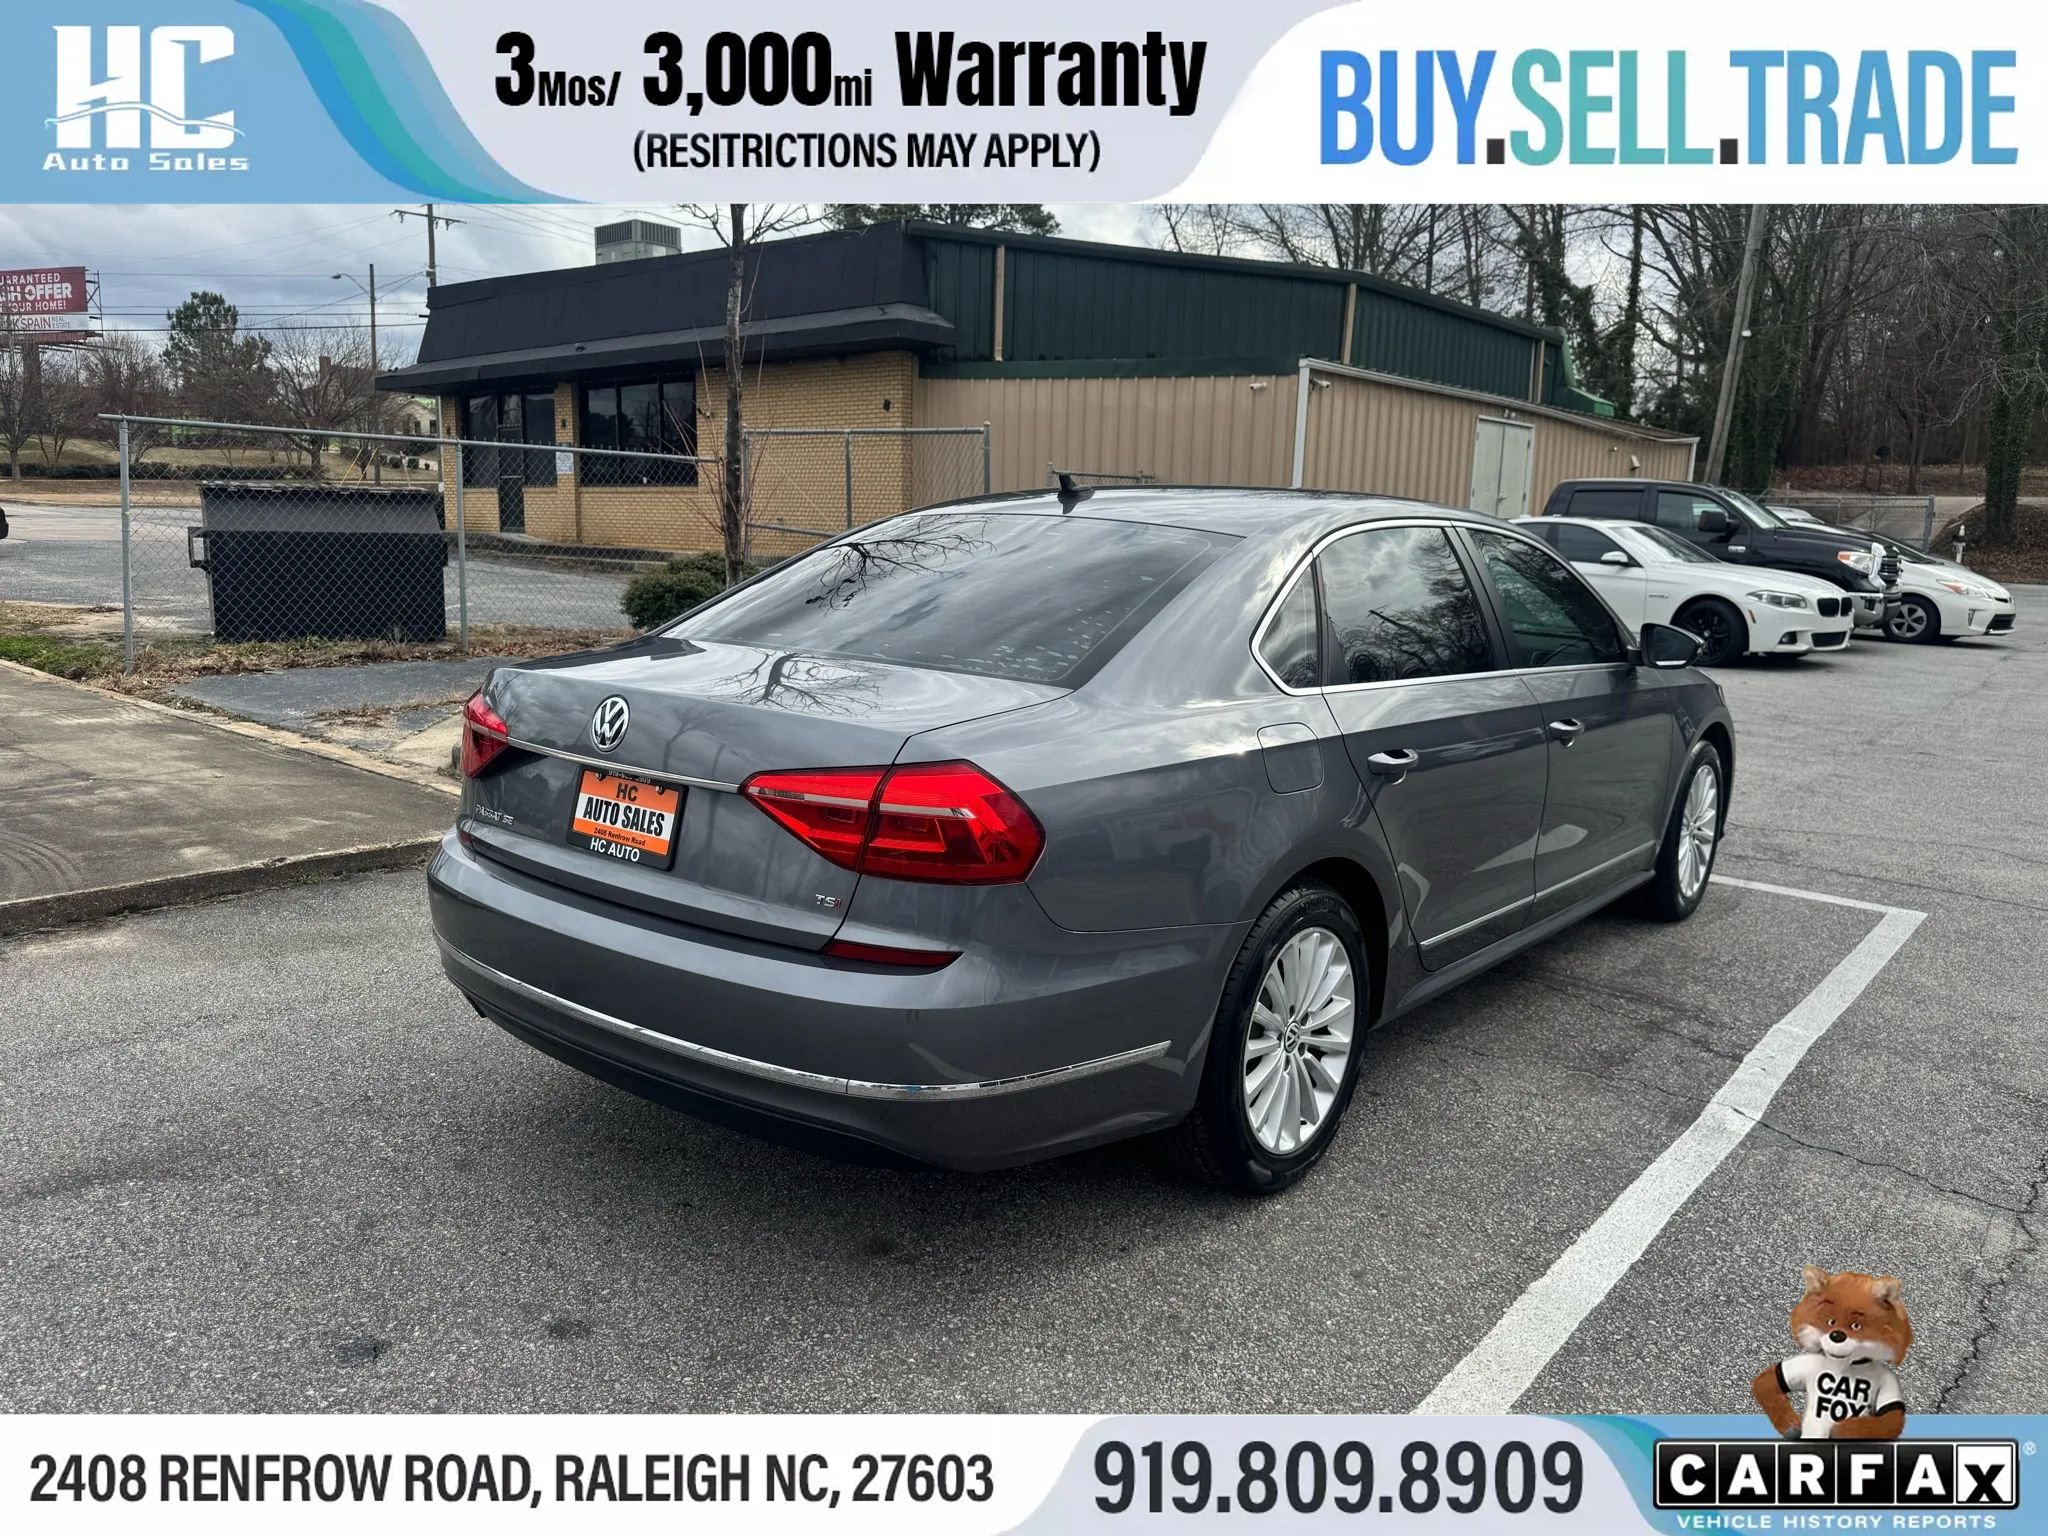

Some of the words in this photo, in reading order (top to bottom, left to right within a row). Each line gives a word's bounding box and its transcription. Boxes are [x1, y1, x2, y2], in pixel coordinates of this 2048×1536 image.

[24, 282, 72, 300] OFFER
[35, 300, 66, 311] HOME!
[616, 783, 638, 802] HC
[583, 797, 620, 826] AUTO
[621, 805, 665, 837] SALES
[590, 837, 606, 853] HC
[608, 843, 640, 862] AUTO
